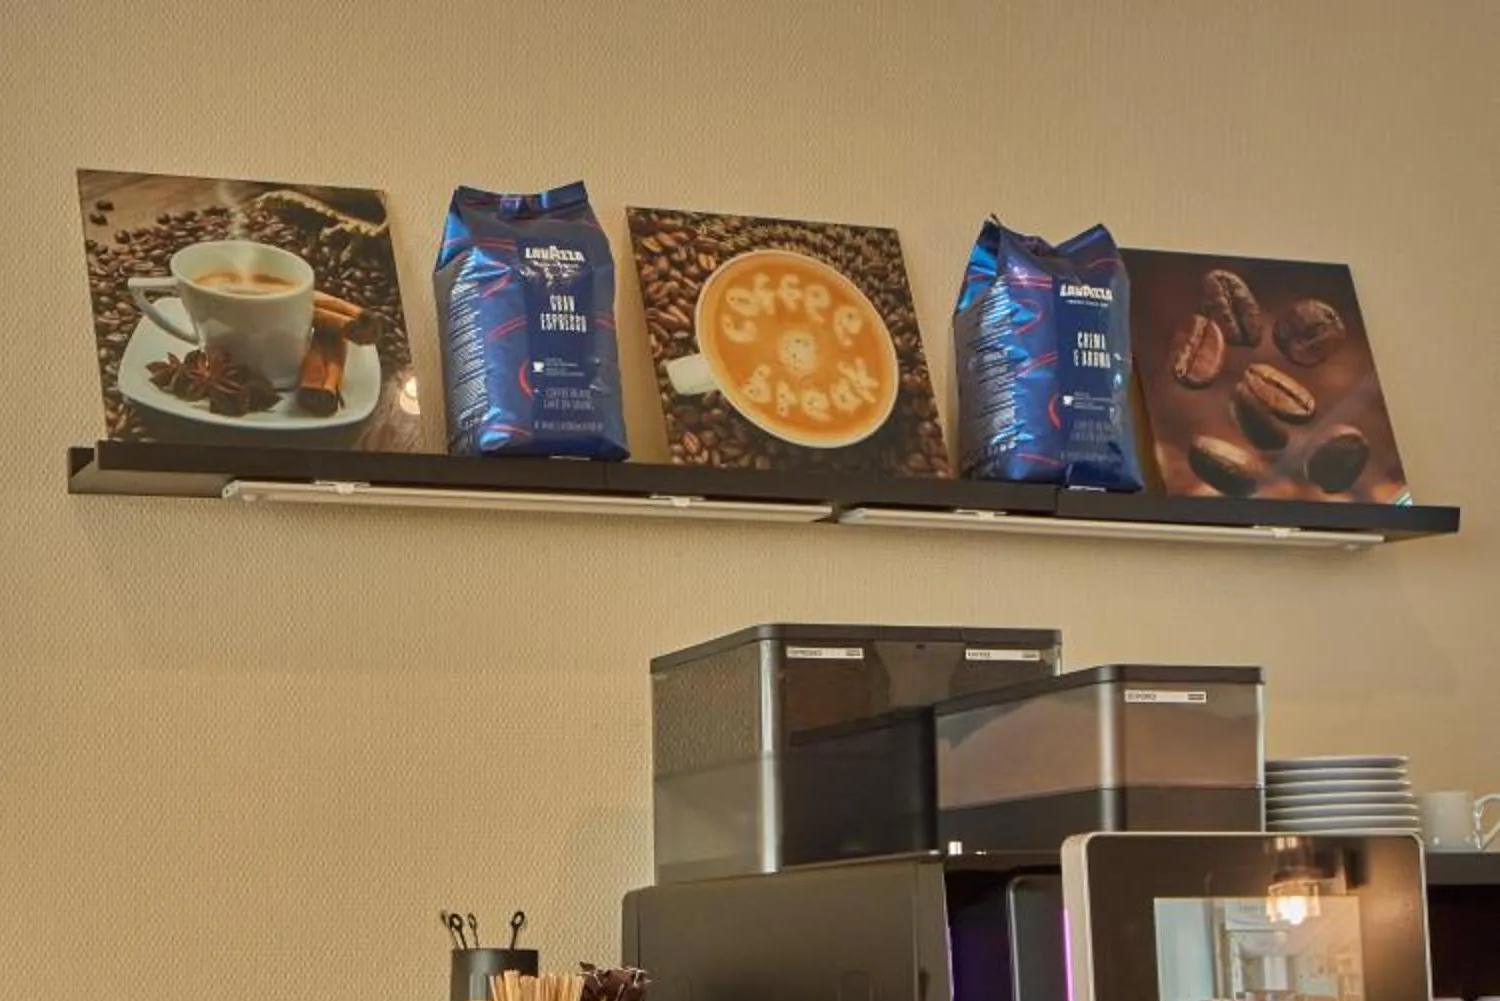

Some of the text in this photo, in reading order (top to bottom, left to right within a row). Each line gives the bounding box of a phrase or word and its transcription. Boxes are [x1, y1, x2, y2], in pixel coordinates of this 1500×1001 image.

[525, 246, 585, 262] LAVAZZA
[1060, 284, 1113, 301] LAVAZZA
[541, 313, 587, 333] ESPRESSO
